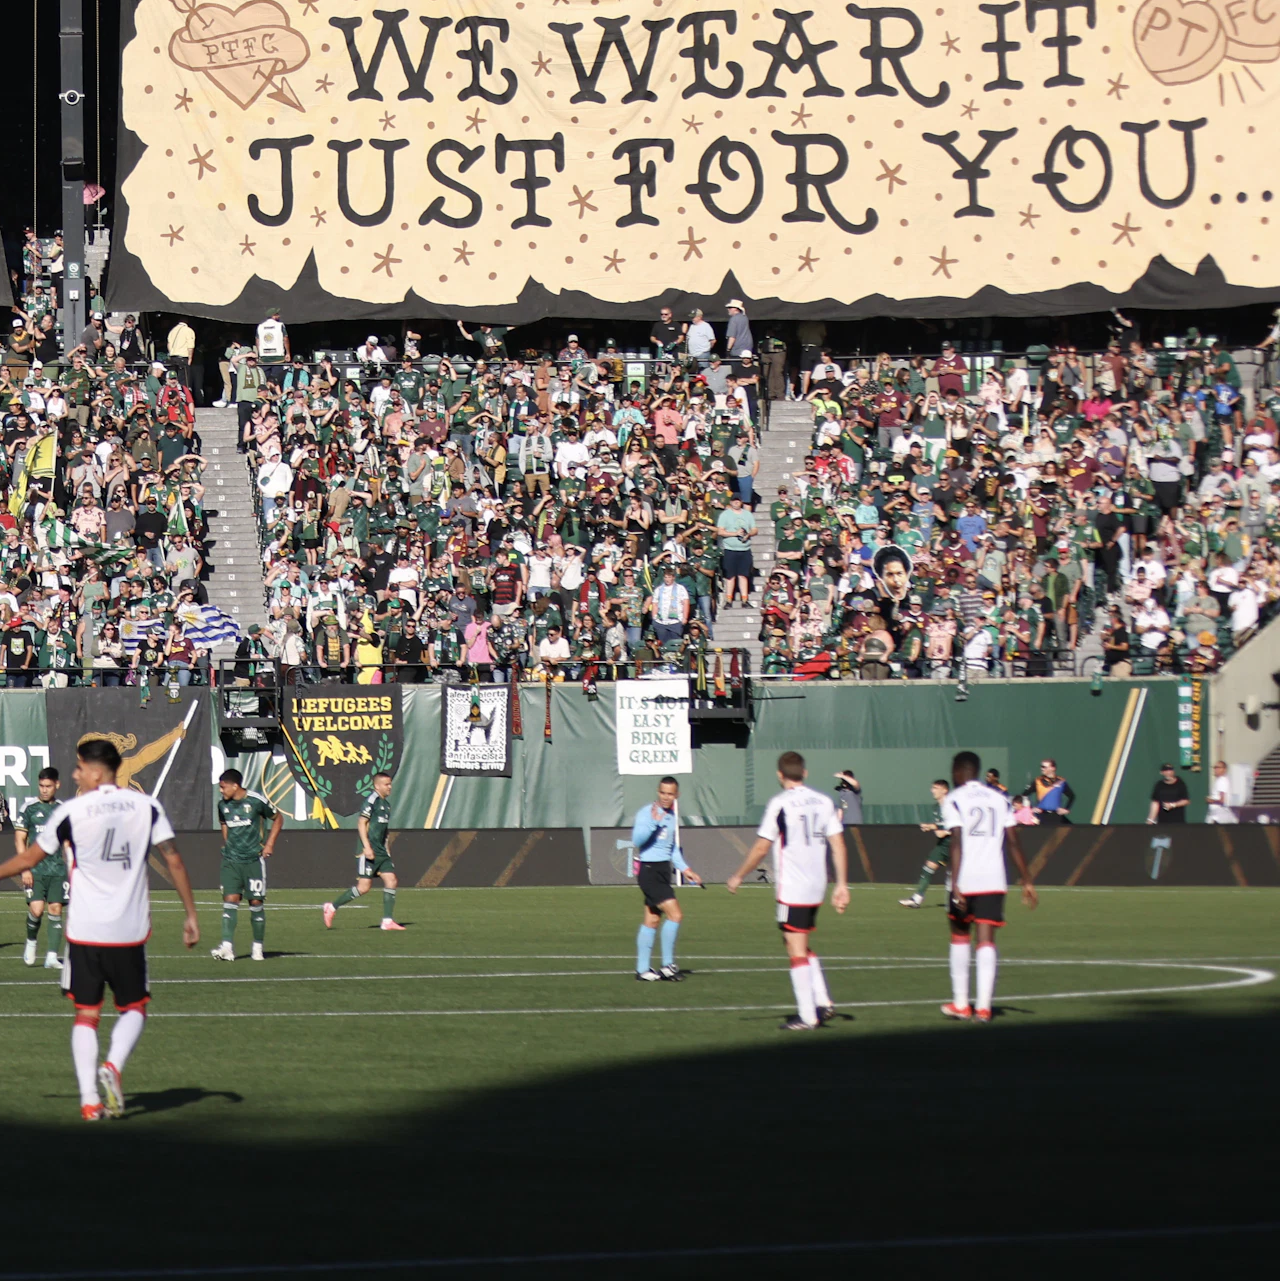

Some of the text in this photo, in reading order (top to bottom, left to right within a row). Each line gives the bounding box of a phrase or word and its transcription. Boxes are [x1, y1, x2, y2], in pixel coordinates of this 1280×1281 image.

[201, 32, 279, 65] PTFC
[328, 8, 519, 106] WE
[548, 3, 950, 108] WEAR
[247, 131, 564, 229] JUST
[613, 128, 879, 235] FOR
[292, 714, 393, 732] WELCOME
[632, 713, 675, 728] EASY
[631, 731, 678, 746] BEING
[629, 749, 680, 764] GREEN
[968, 807, 997, 838] 21
[101, 828, 131, 870] 4
[249, 879, 263, 893] 10
